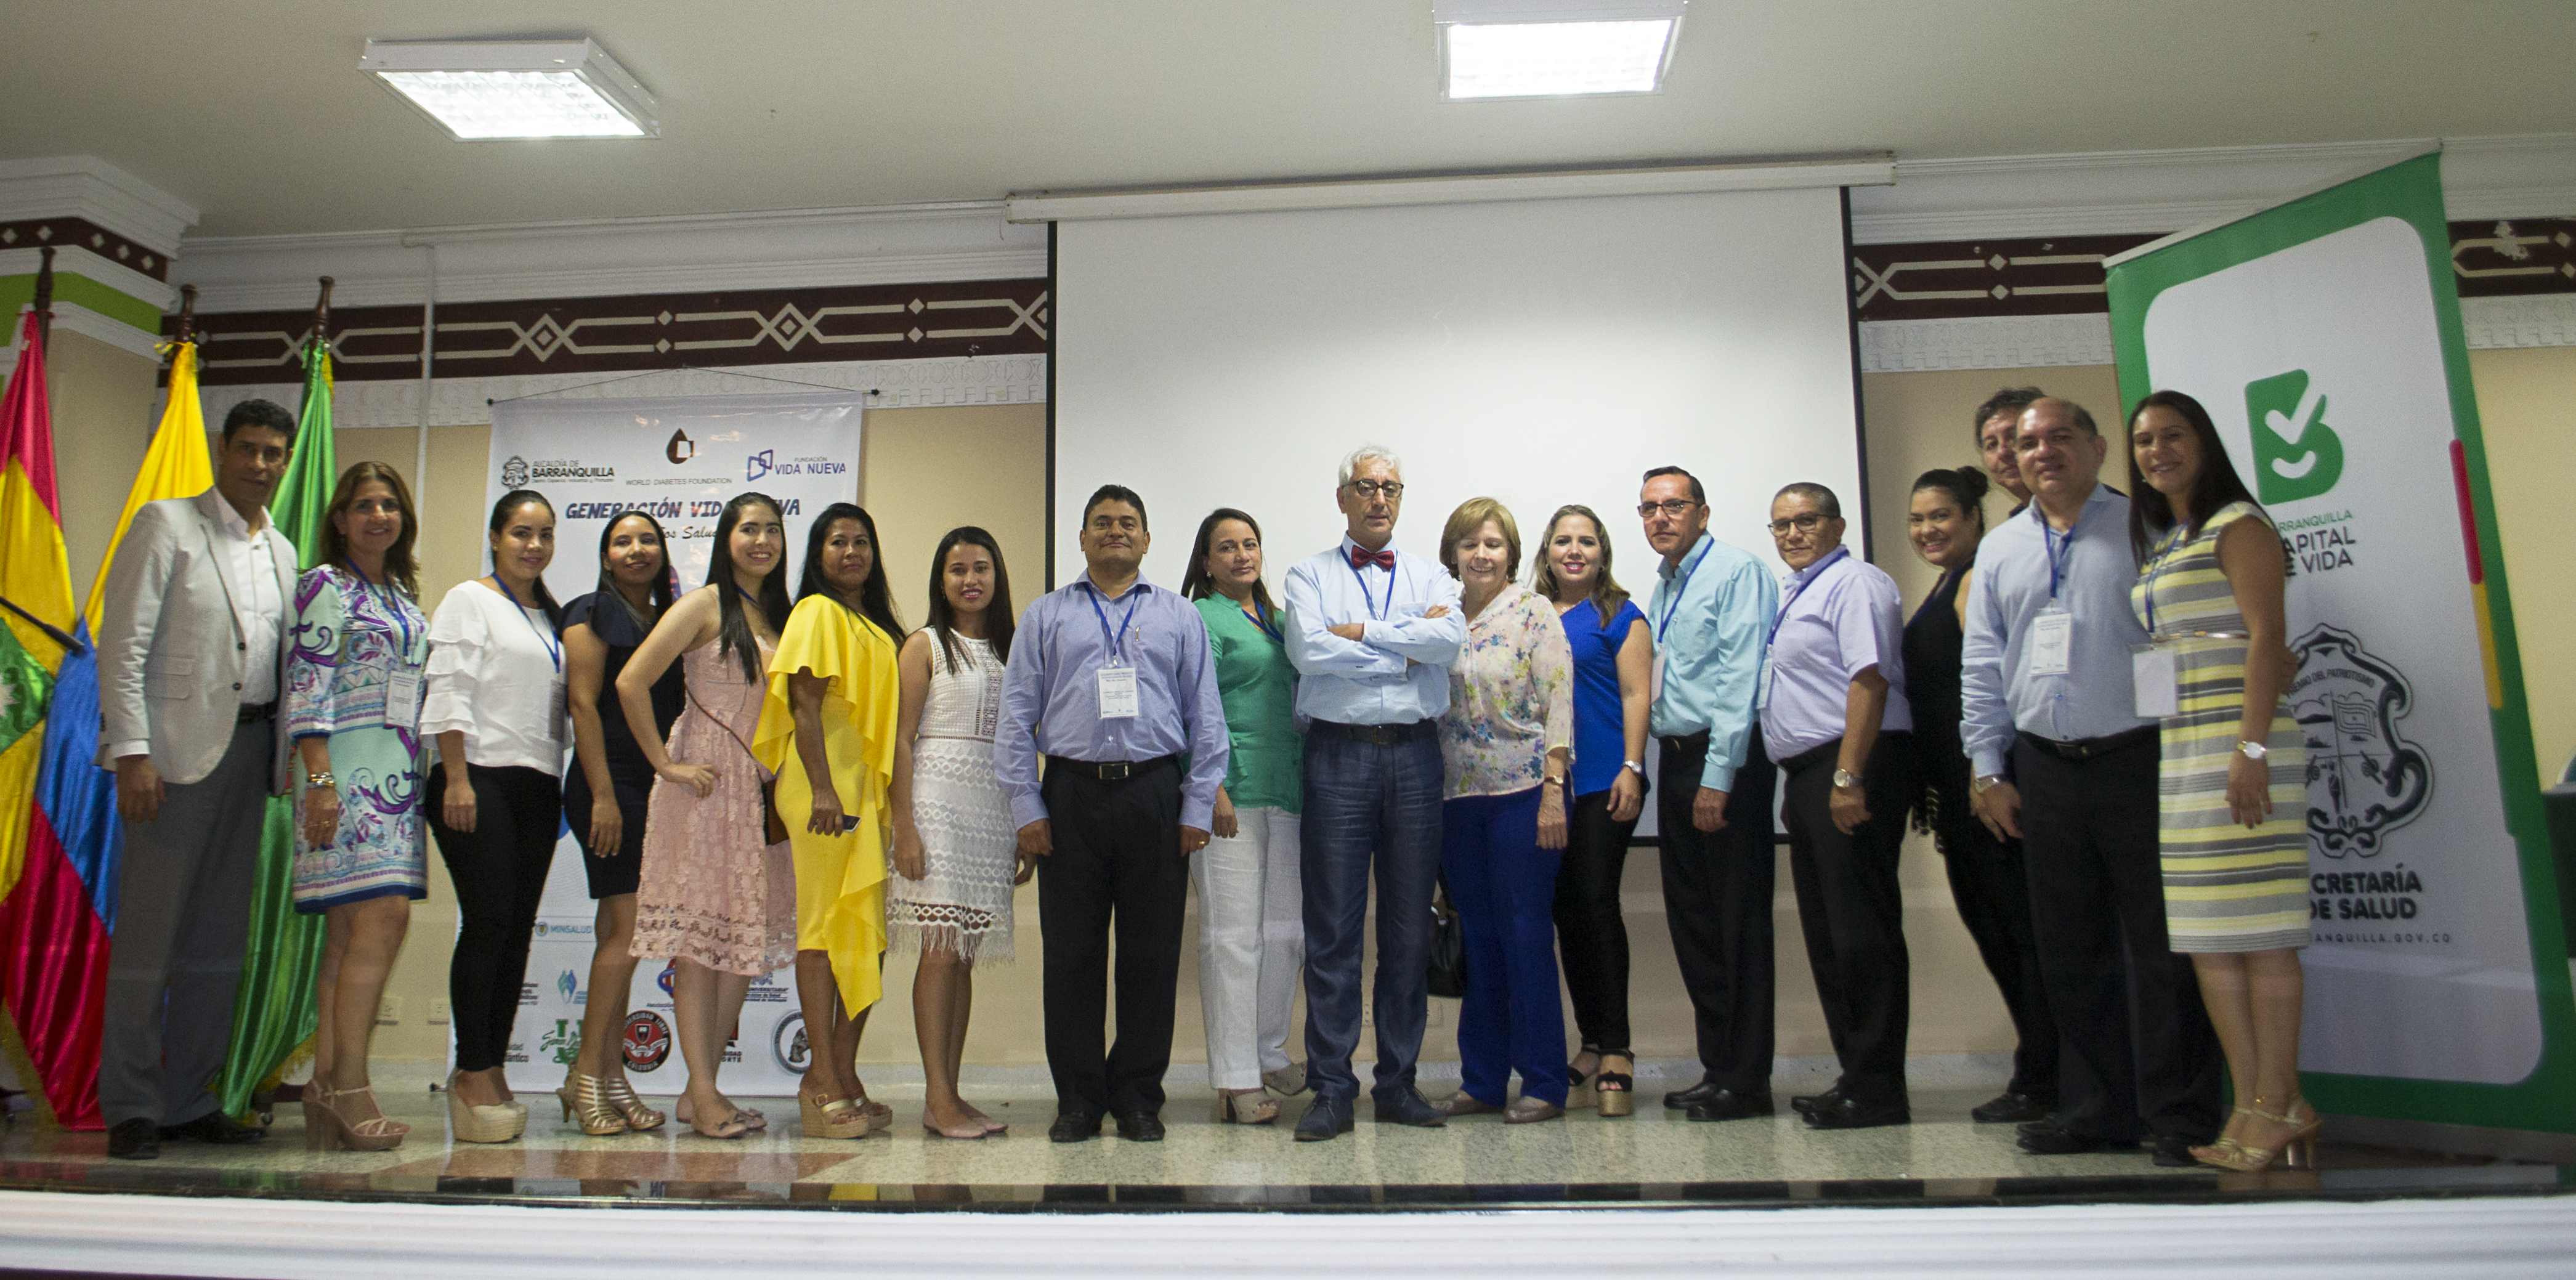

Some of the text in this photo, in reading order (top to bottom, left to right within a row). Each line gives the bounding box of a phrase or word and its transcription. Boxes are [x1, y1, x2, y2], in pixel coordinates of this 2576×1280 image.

[532, 468, 614, 477] BARRANQUILLA
[774, 463, 846, 475] VIDA NUEVA
[690, 501, 723, 517] VID
[2279, 509, 2354, 532] RRANQUILLA
[2282, 525, 2356, 554] APITAL
[2301, 548, 2353, 573] VIDA
[2310, 862, 2423, 894] CRETARÍA
[2338, 897, 2417, 920] SALUD
[2311, 933, 2450, 944] ANQUILLA.GOV.CO
